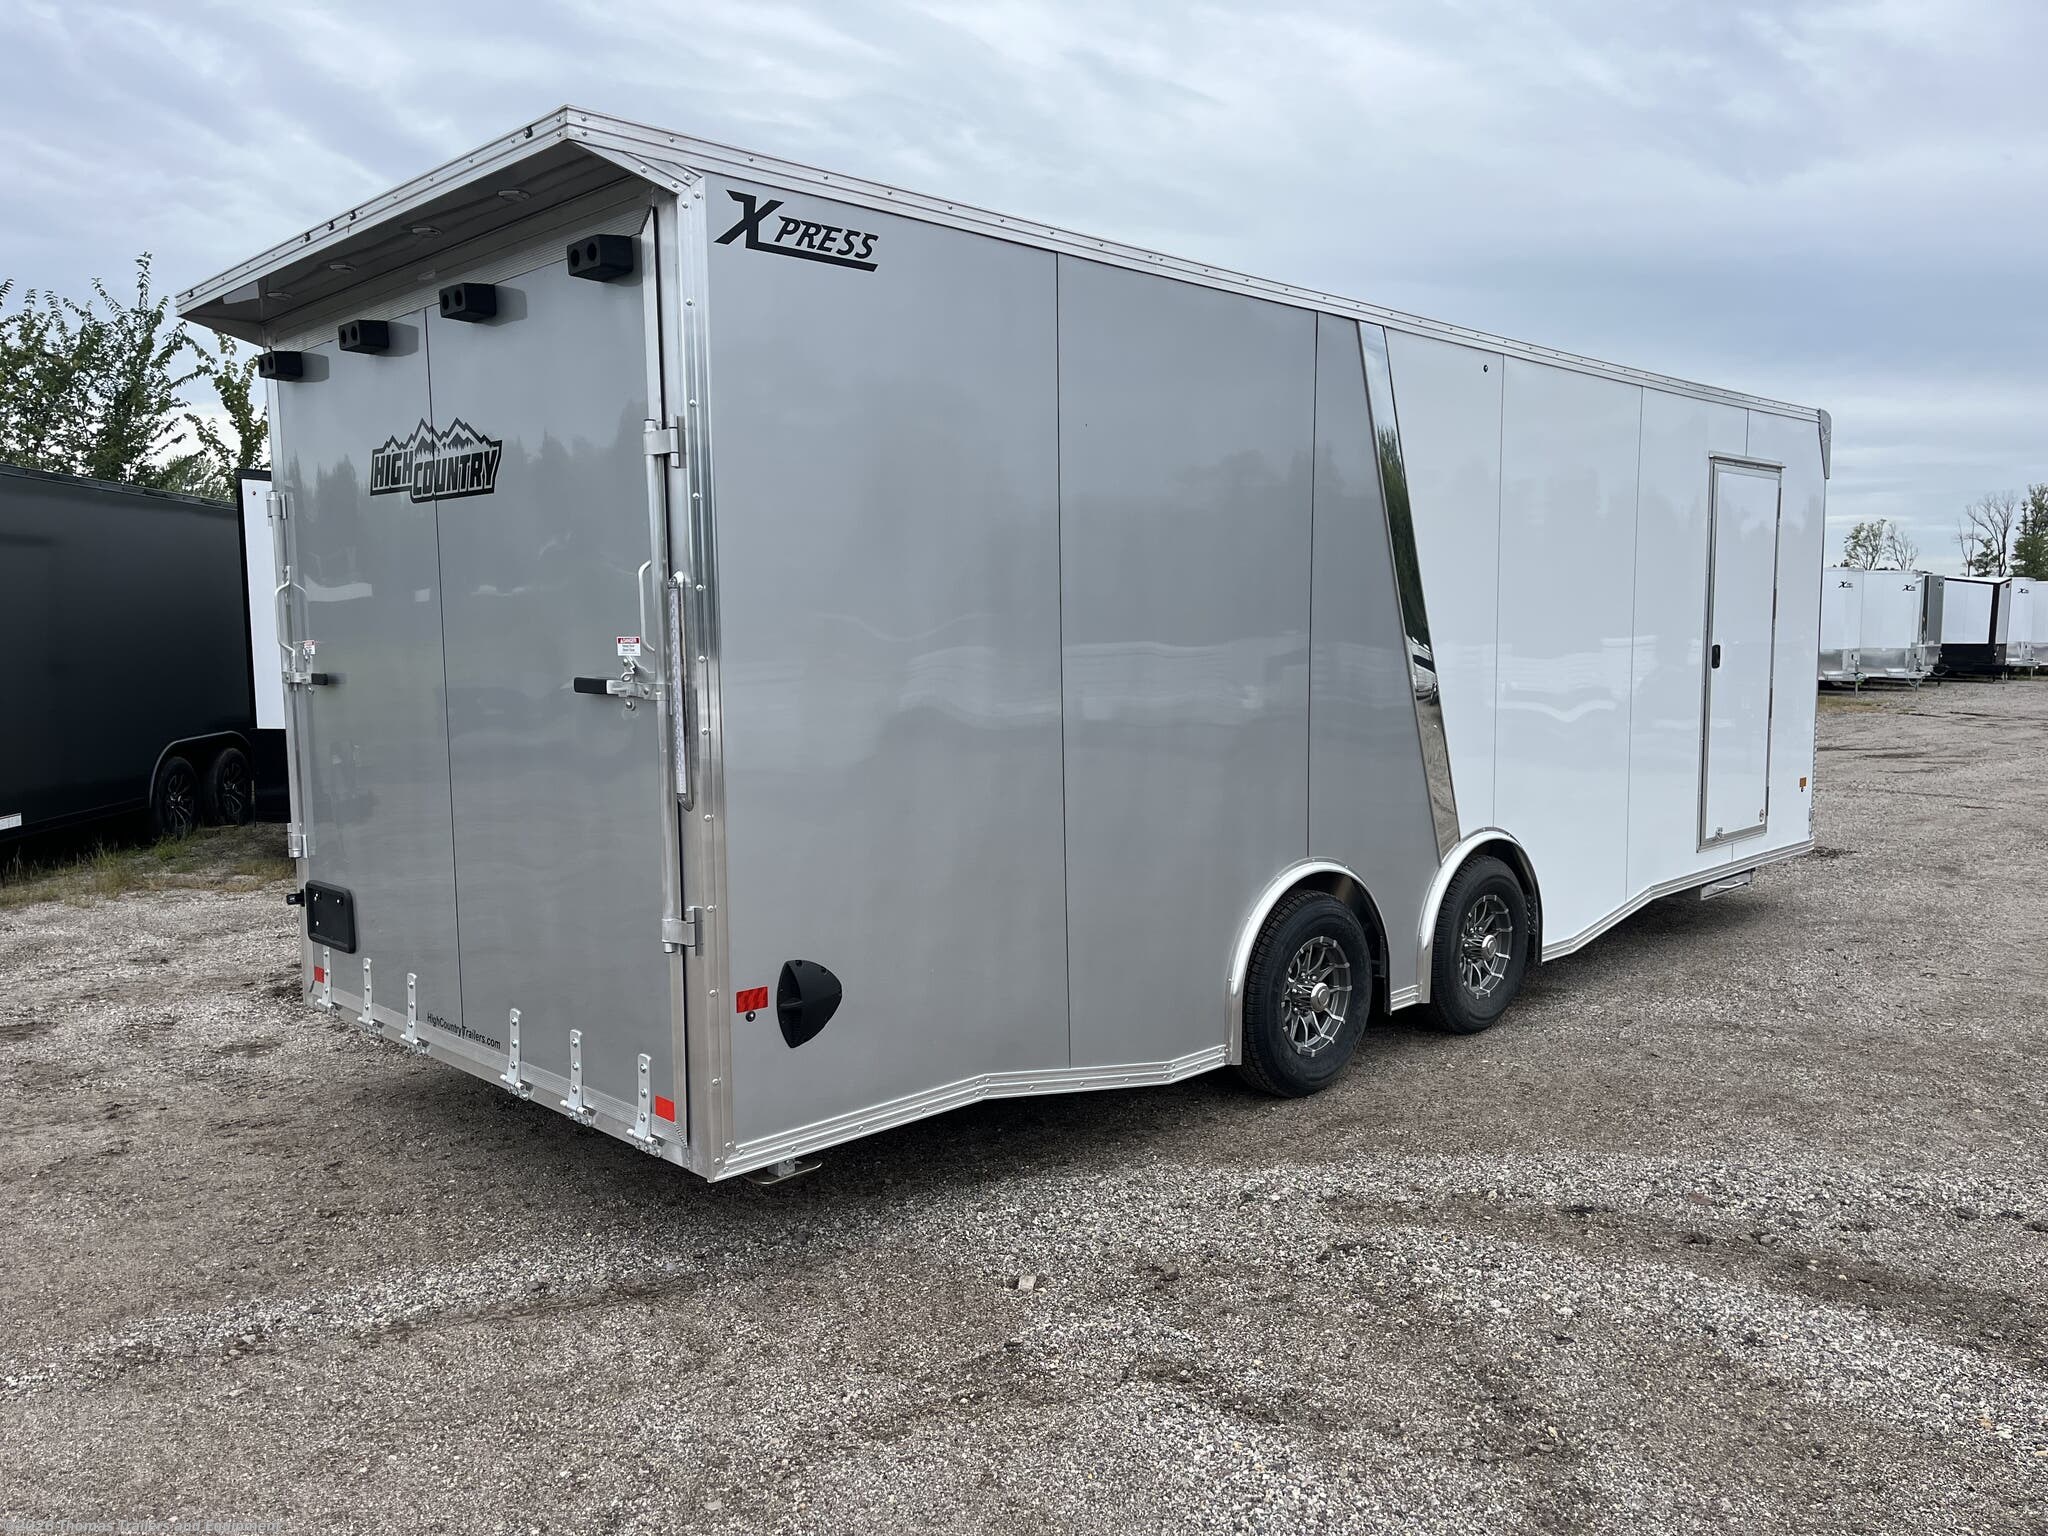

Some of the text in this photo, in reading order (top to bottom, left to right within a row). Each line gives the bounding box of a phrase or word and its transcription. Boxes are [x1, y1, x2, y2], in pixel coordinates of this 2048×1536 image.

[373, 450, 414, 489] HIGH
[413, 448, 500, 497] COUNTRY
[426, 1012, 501, 1050] HighCountryTrailers.com
